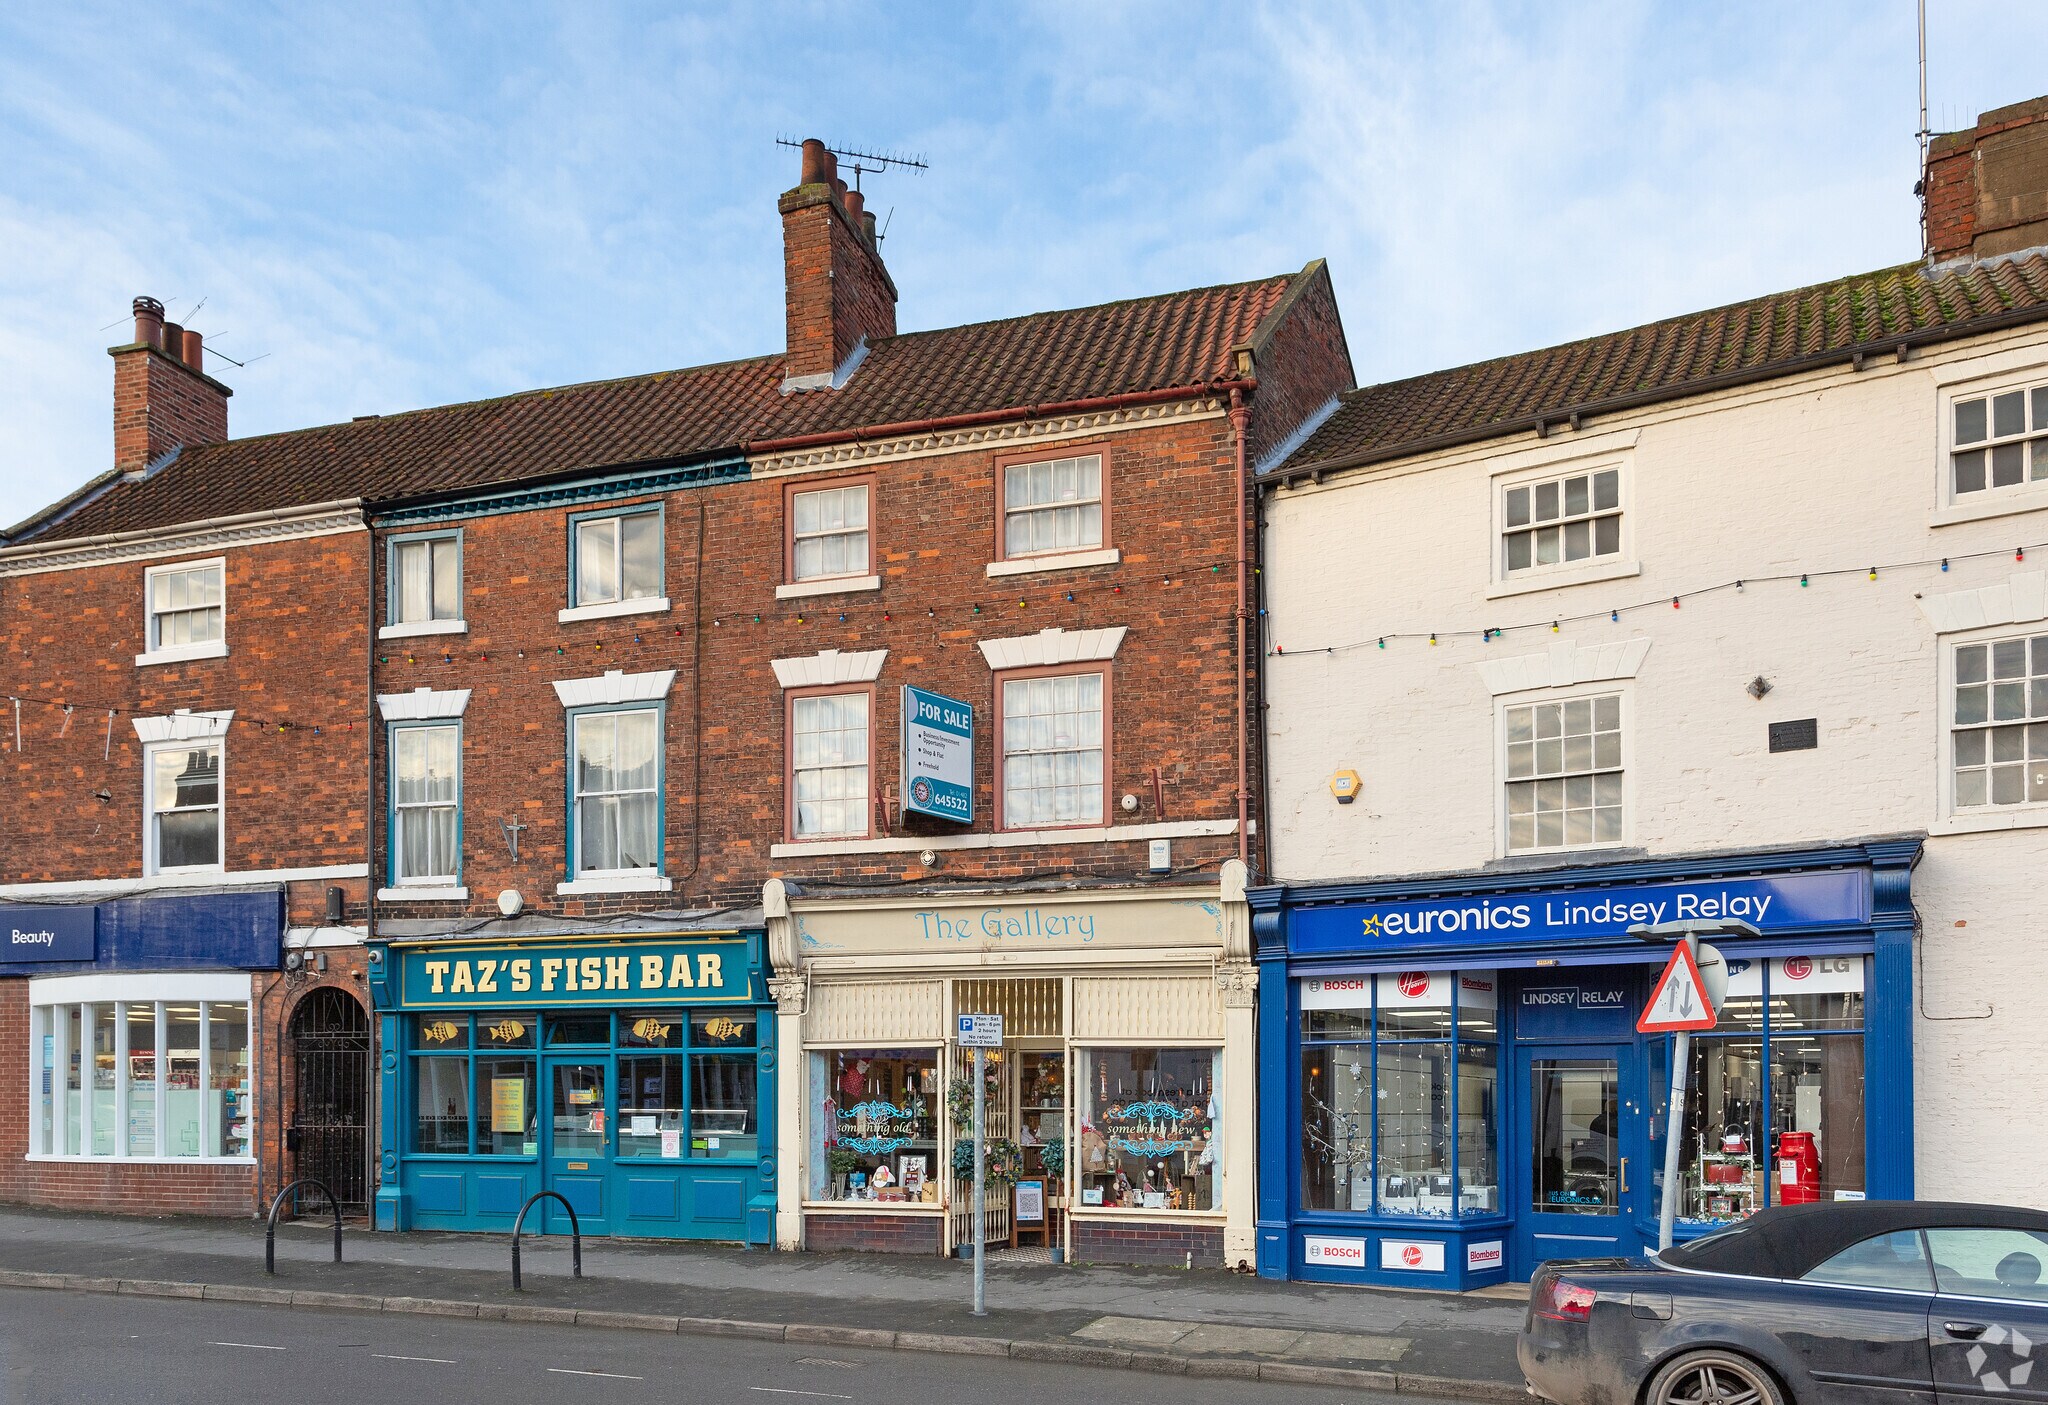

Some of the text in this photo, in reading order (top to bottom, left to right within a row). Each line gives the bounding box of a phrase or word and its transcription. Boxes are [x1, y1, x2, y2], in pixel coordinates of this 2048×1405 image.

[920, 701, 969, 730] FOR SALE
[934, 794, 968, 811] 645522
[1383, 891, 1772, 935] euronics Lindsey Relay
[914, 908, 1095, 942] The Gallery
[12, 930, 54, 946] Beauty
[1820, 957, 1850, 973] LG
[426, 953, 723, 994] TAZ'S FISH BAR
[1324, 980, 1363, 990] BOSCH
[1462, 977, 1492, 990] Blomberg
[1522, 991, 1624, 1004] LINDSEY RELAY
[963, 1020, 970, 1029] P
[837, 1122, 890, 1136] something
[1107, 1122, 1196, 1136] something new
[1324, 1247, 1360, 1258] BOSCH
[1470, 1250, 1499, 1260] Blomberg
